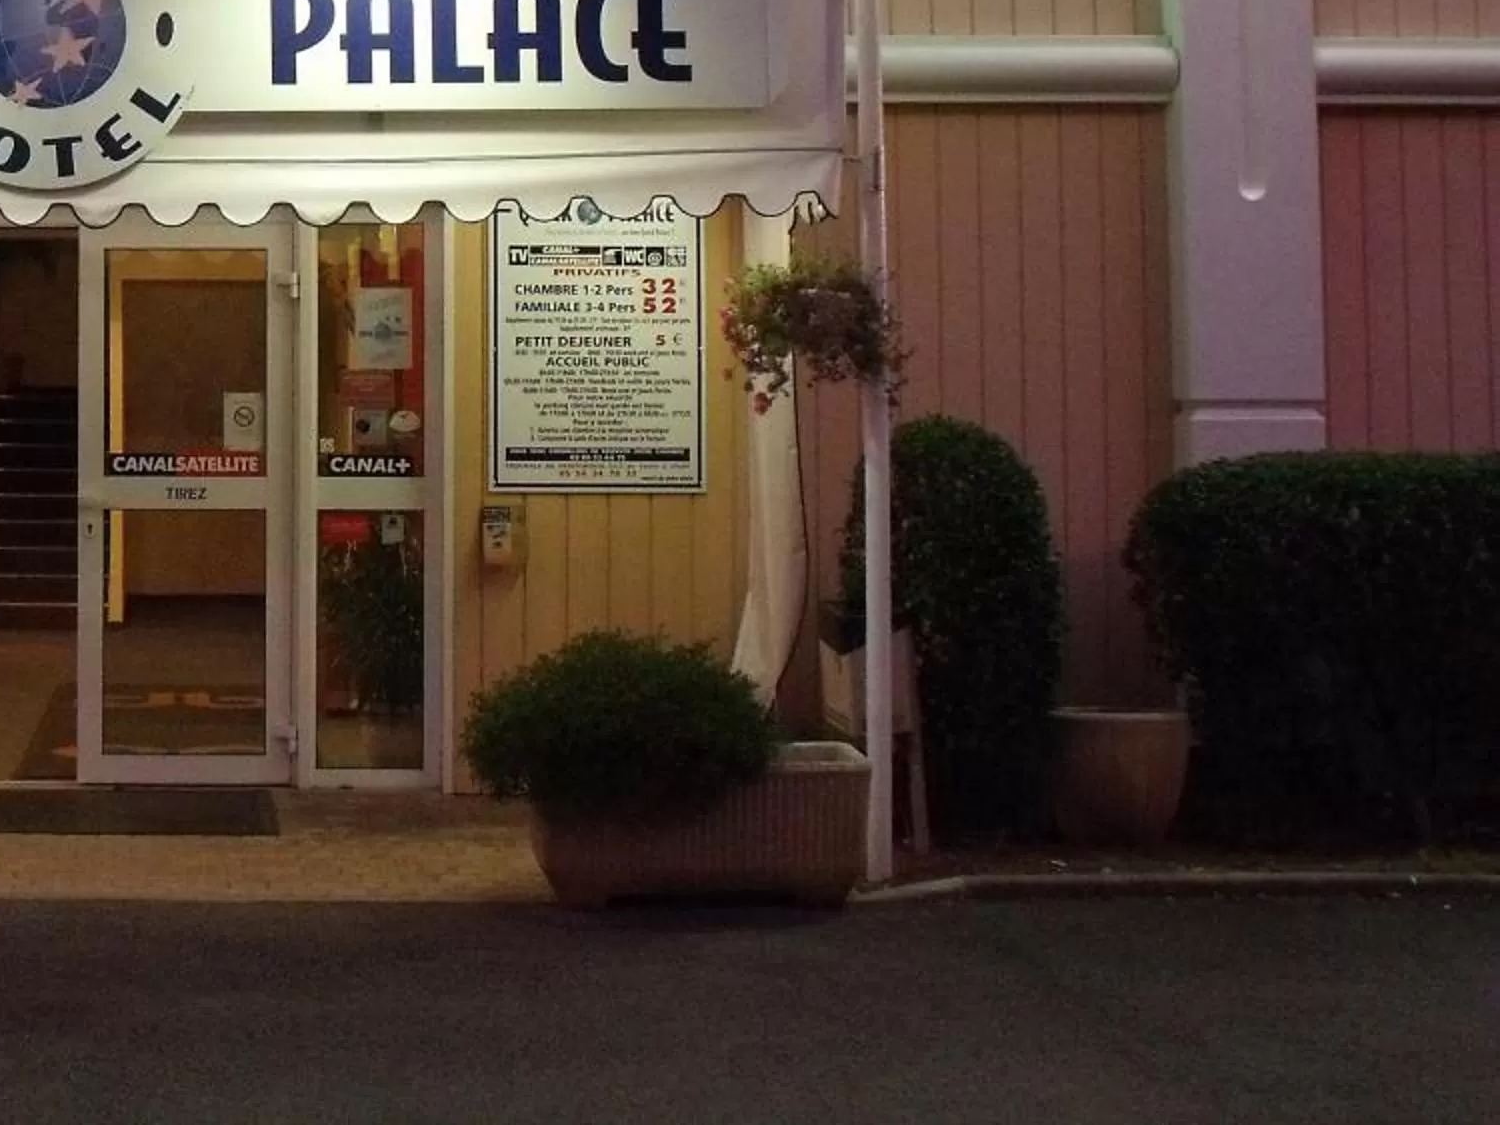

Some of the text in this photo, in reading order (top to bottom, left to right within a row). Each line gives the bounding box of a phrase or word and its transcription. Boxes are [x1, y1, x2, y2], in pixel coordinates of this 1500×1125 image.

[510, 249, 528, 263] TV
[625, 248, 644, 263] WC
[515, 284, 578, 295] CHAMBRE
[583, 284, 601, 295] 1-2
[606, 284, 633, 295] Pers
[642, 279, 676, 294] 32
[515, 302, 580, 313] FAMILIALE
[585, 302, 605, 312] 3-4
[609, 302, 636, 313] Pers
[642, 298, 676, 314] 52
[515, 336, 553, 347] PETIT
[558, 336, 632, 347] DEJEUNER
[655, 335, 665, 346] 5
[546, 357, 649, 367] ACCUEIL PUBLIC
[113, 456, 259, 473] CANALSATELLITE
[330, 457, 411, 474] CANAL+
[165, 487, 208, 500] TIREZ
